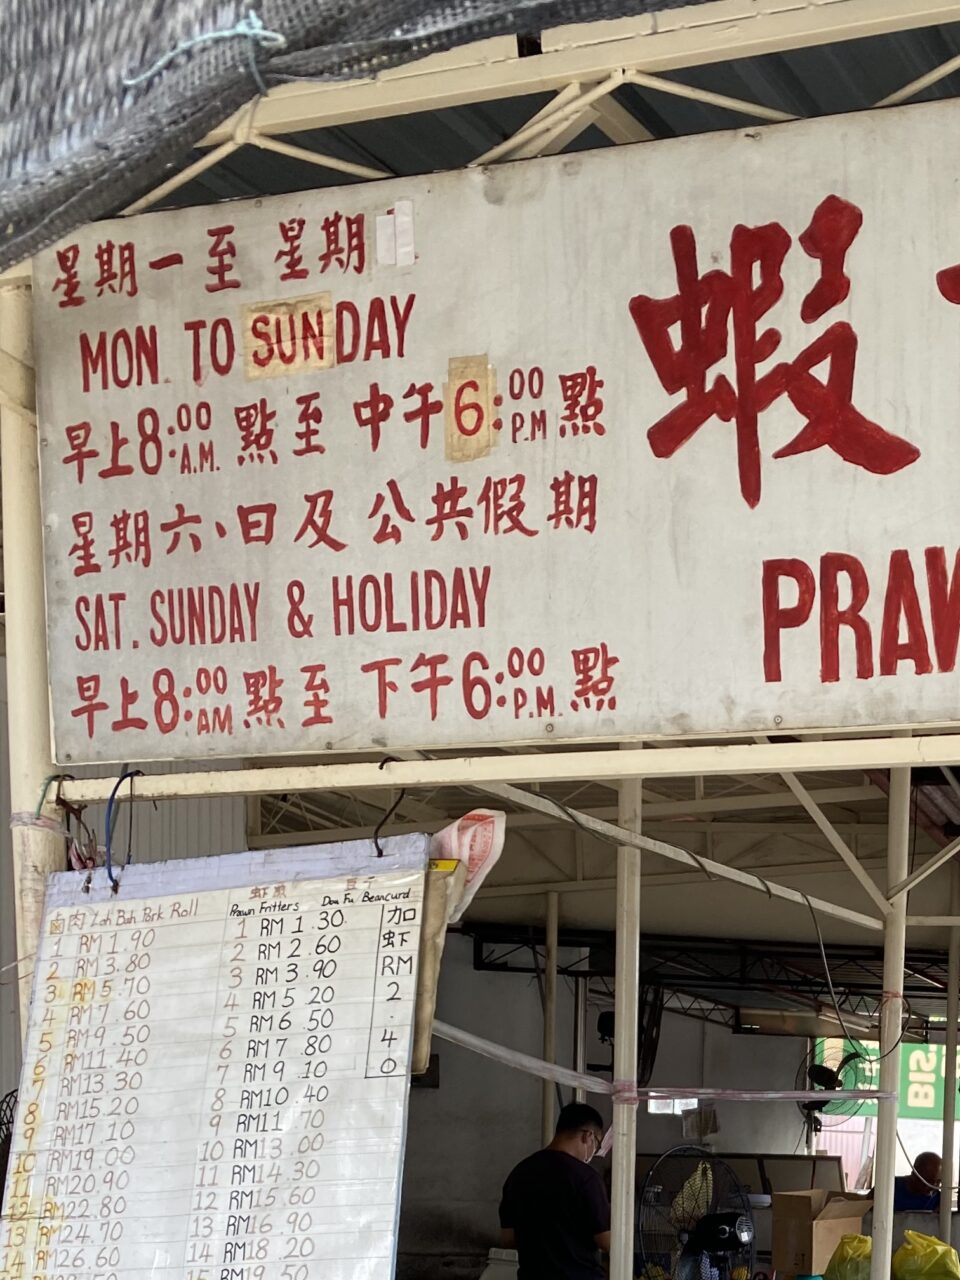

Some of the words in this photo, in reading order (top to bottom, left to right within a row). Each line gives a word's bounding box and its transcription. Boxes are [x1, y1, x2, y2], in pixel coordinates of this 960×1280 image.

[184, 317, 235, 384] TO
[250, 294, 416, 369] SUNDAY
[75, 594, 140, 651] SAT.
[149, 582, 260, 648] SUNDAY
[286, 580, 315, 639] &
[332, 566, 491, 636] HOLIDAY
[362, 888, 411, 903] Beancurd
[143, 905, 164, 923] Pork
[170, 898, 199, 919] Roll
[229, 904, 255, 917] Prawn
[259, 901, 299, 914] Fritters
[235, 917, 248, 940] 1
[51, 938, 63, 957] 1
[230, 943, 246, 962] 2
[46, 962, 59, 980] 2
[381, 955, 413, 976] RM
[228, 966, 243, 989] 3
[45, 985, 56, 1003] 3
[223, 991, 239, 1012] 4
[42, 1008, 56, 1026] 4
[222, 1017, 239, 1038] 5
[39, 1032, 53, 1052] 5
[219, 1040, 232, 1060] 6
[33, 1054, 48, 1076] 6
[216, 1064, 229, 1085] 7
[32, 1078, 45, 1102] 7
[211, 1088, 226, 1112] 8
[23, 1102, 39, 1125] 8
[209, 1114, 222, 1137] 9
[23, 1127, 35, 1150] 9
[199, 1140, 224, 1162] 10
[13, 1153, 36, 1175] 10
[10, 1175, 30, 1198] 11
[195, 1165, 219, 1187] 11
[8, 1201, 29, 1222] 12
[192, 1191, 219, 1211] 12
[4, 1226, 26, 1248] 13
[190, 1216, 213, 1238] 13
[0, 1252, 25, 1274] 14
[187, 1243, 213, 1263] 14
